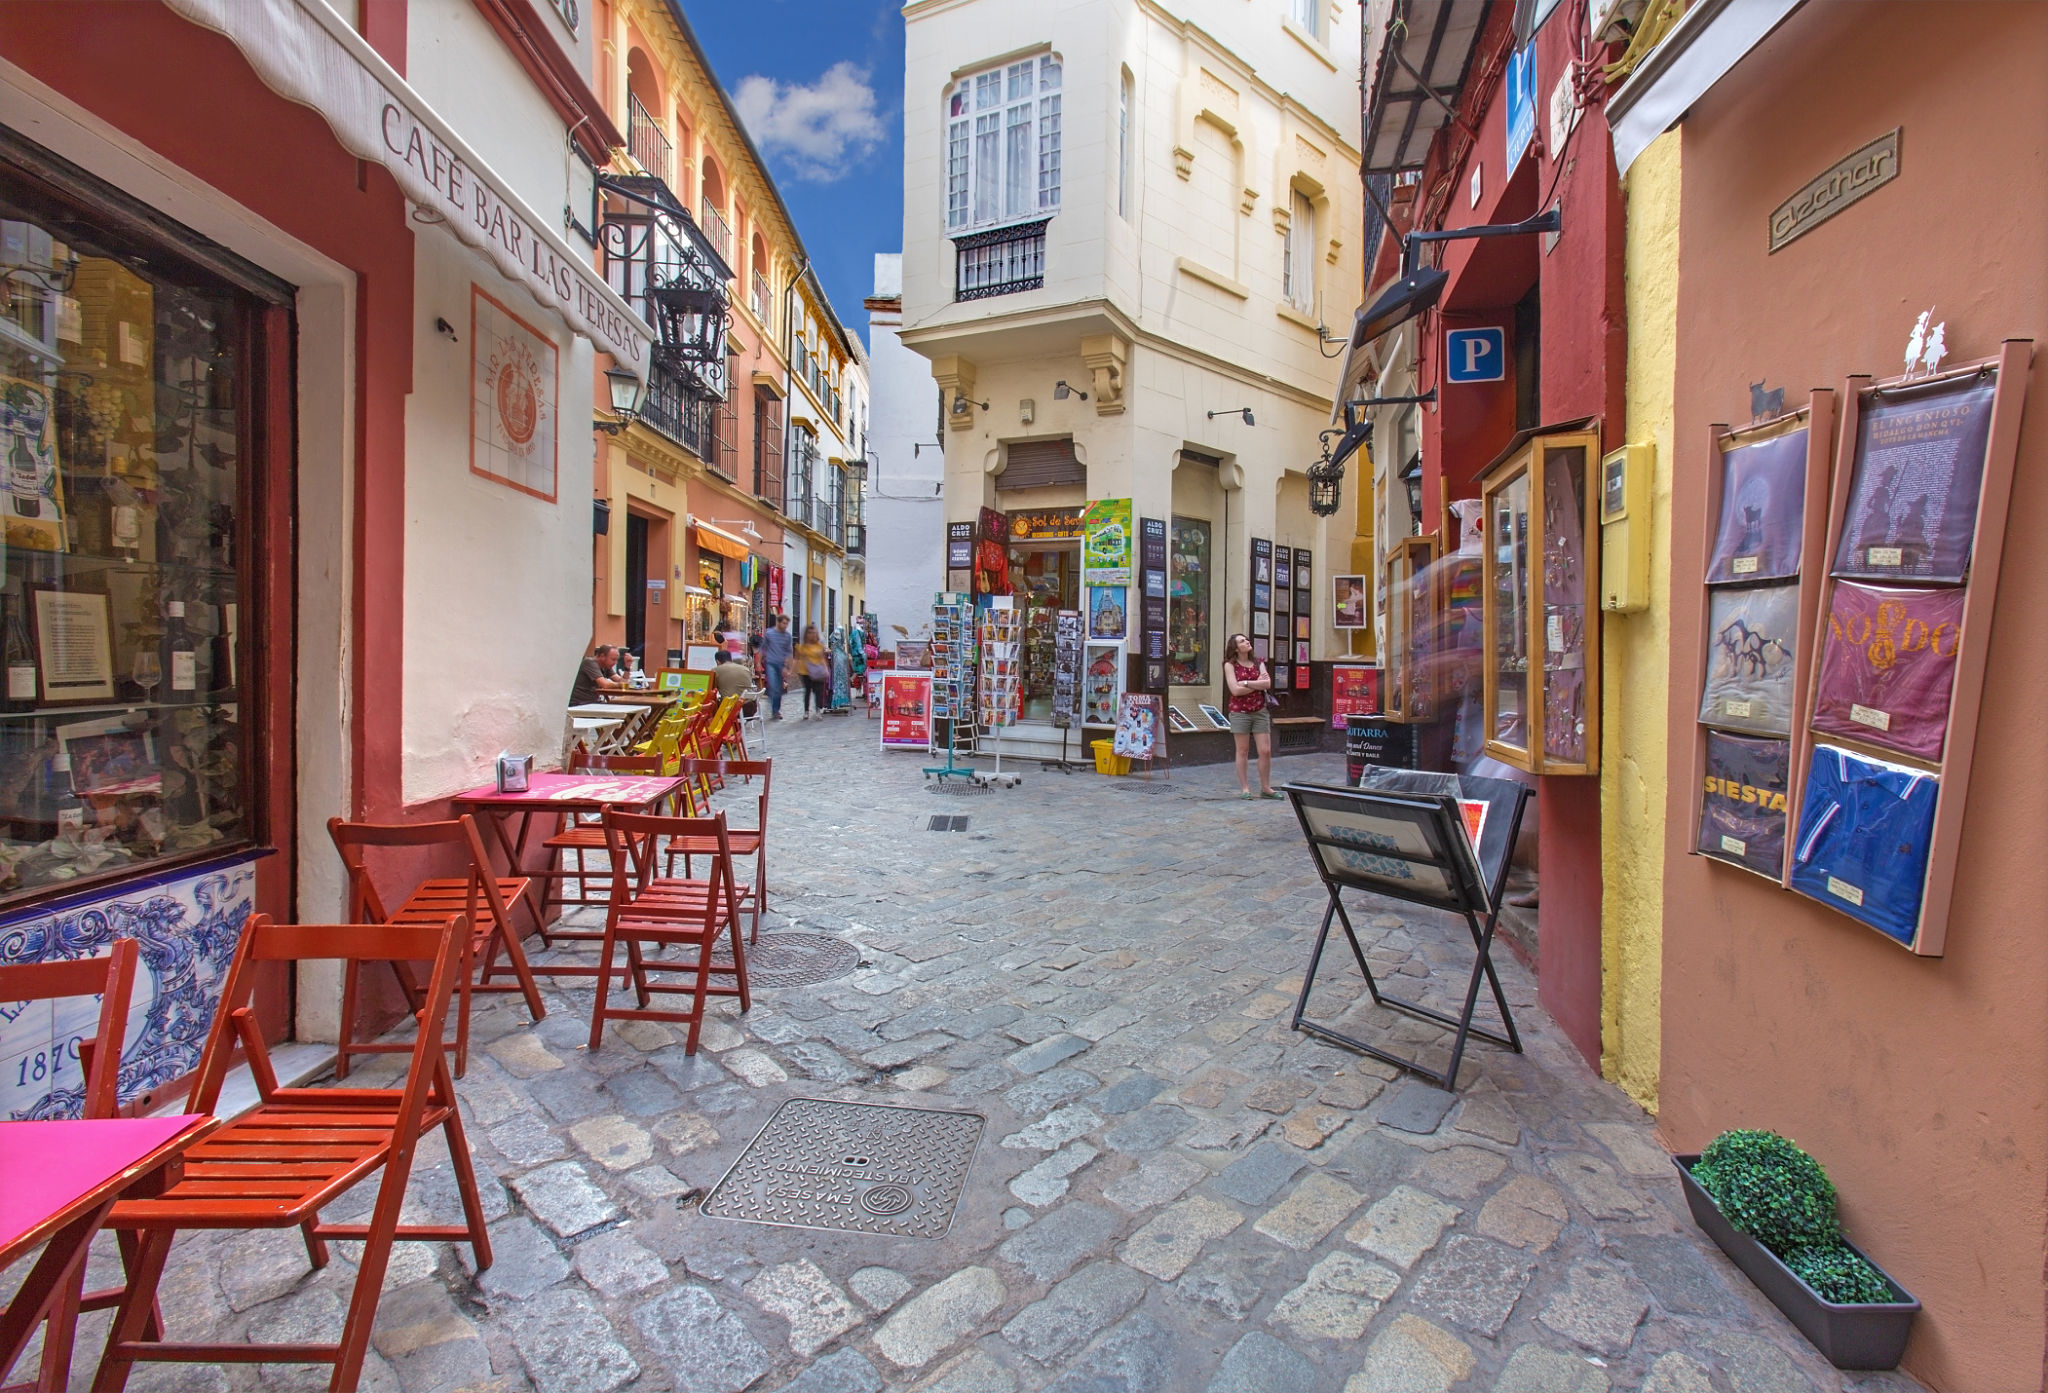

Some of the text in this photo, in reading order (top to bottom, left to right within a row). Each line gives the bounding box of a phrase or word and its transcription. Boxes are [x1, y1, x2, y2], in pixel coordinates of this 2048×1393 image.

[381, 103, 641, 362] CAFÉ BAR LAS TERESAS
[1461, 338, 1491, 373] P
[1032, 514, 1048, 527] Sol
[1049, 513, 1061, 526] de
[1147, 520, 1163, 529] ALDO
[1146, 527, 1163, 535] CRUZ
[1256, 540, 1270, 548] ALDO
[1256, 546, 1270, 554] CRUZ
[1276, 547, 1289, 555] ALDO
[1276, 552, 1289, 560] CRUZ
[1128, 694, 1151, 702] TOMA
[1704, 775, 1787, 813] SIESTA
[16, 1035, 84, 1087] 1870
[776, 1161, 923, 1185] ABASTECIMIENTO
[765, 1186, 854, 1205] EMASESA
